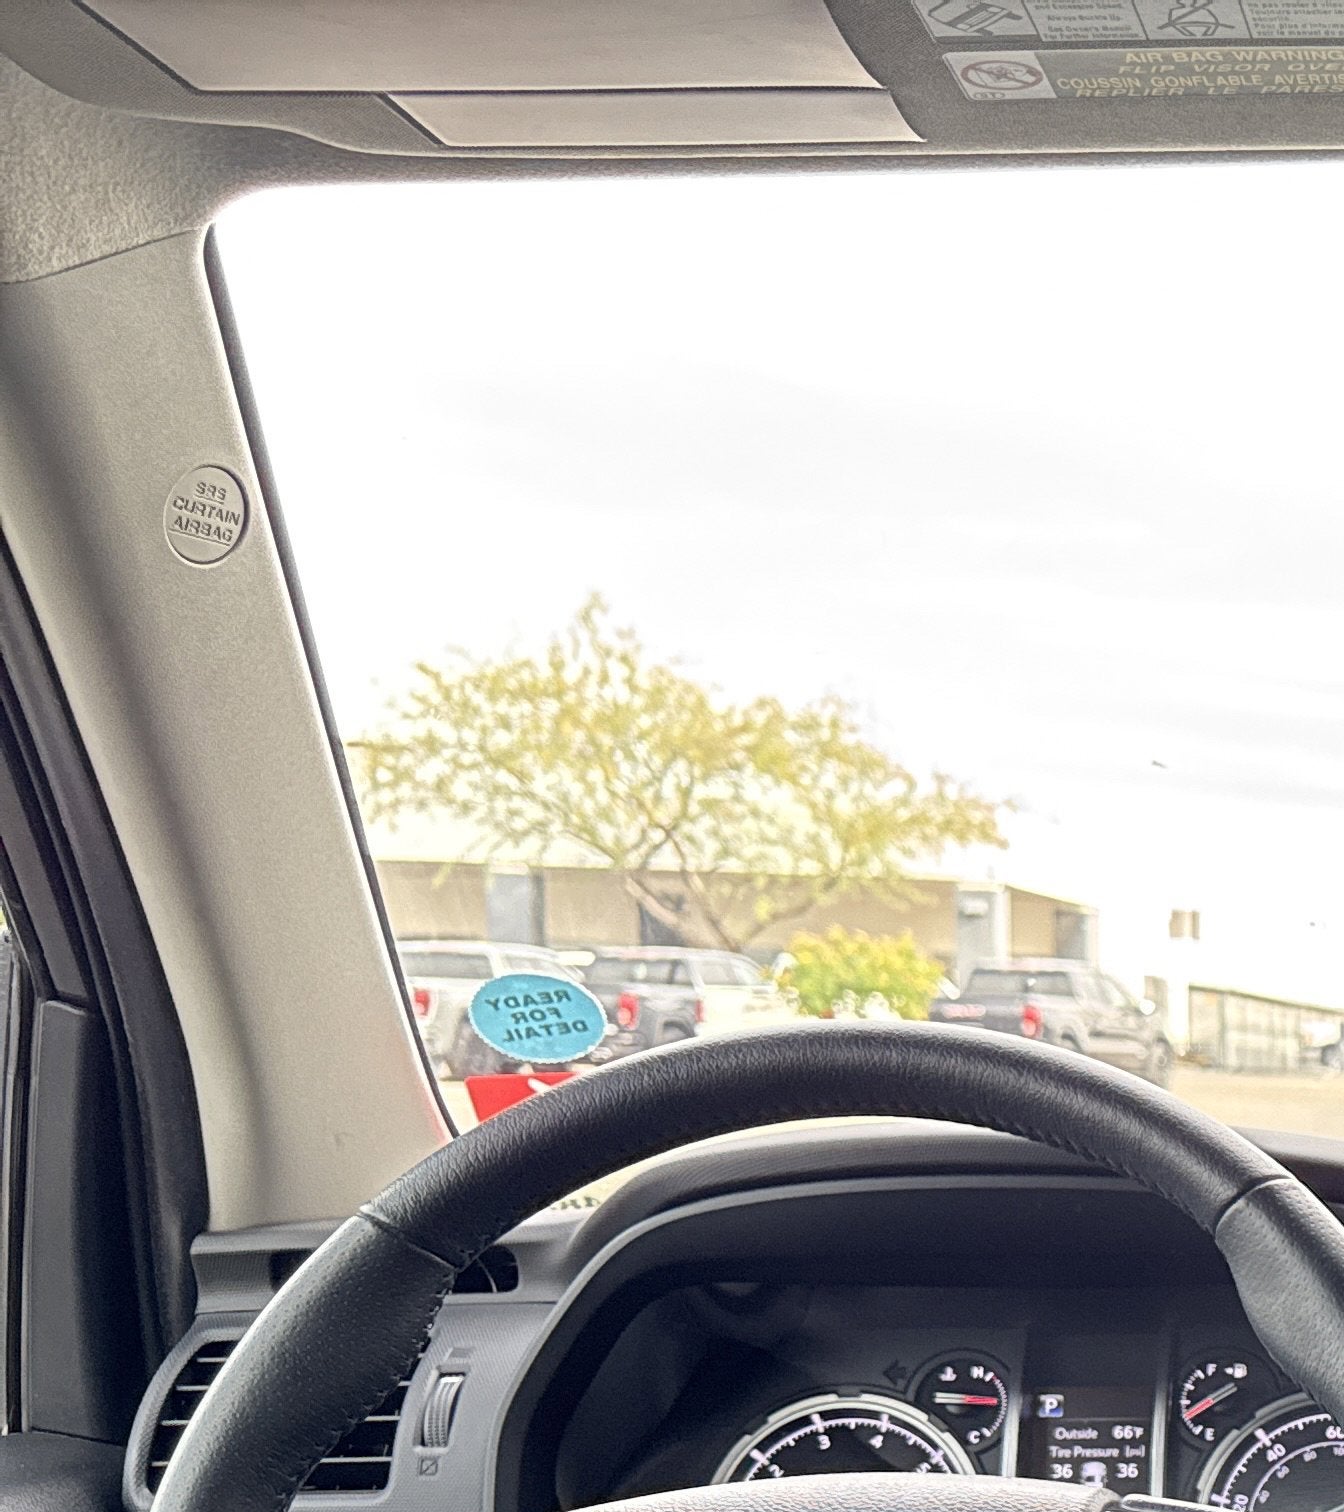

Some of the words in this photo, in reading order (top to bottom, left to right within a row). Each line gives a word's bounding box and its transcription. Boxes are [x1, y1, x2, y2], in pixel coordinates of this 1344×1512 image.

[1125, 52, 1163, 64] AIR
[1172, 51, 1224, 62] BAG
[1232, 50, 1344, 62] WARNING
[1119, 66, 1175, 74] FLIP
[1194, 63, 1271, 73] VISOR
[1056, 78, 1141, 90] COUSSIN
[1151, 75, 1264, 89] GONFLABLE
[1076, 87, 1186, 98] REPLIER
[1207, 86, 1237, 95] LE
[195, 481, 227, 502] SRS
[172, 495, 241, 527] CURTAIN
[173, 515, 234, 543] AIRBAG
[966, 1430, 981, 1444] C
[1054, 1426, 1099, 1440] Outside
[1204, 1427, 1215, 1441] E
[817, 1433, 832, 1450] 3
[868, 1433, 885, 1450] 4
[1048, 1445, 1073, 1458] Tire
[1073, 1445, 1120, 1458] Pressure
[1265, 1443, 1287, 1463] 40
[1050, 1462, 1074, 1479] 36
[1115, 1462, 1139, 1479] 36
